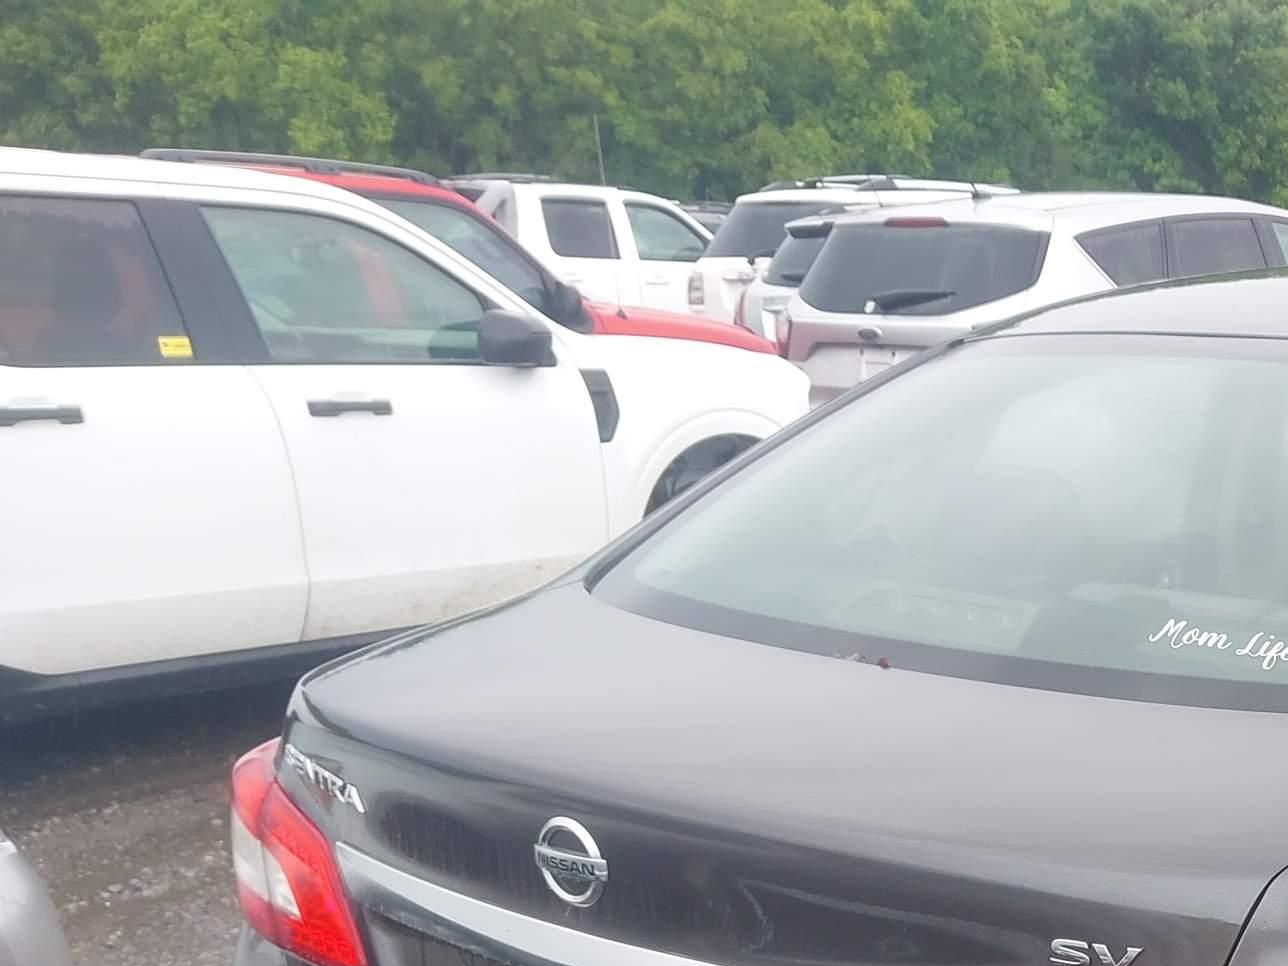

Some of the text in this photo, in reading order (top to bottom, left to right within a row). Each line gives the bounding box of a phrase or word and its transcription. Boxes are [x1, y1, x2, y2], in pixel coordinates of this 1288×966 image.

[1148, 618, 1232, 649] Mom
[285, 743, 365, 814] SENTRA
[537, 850, 596, 877] NISSAN
